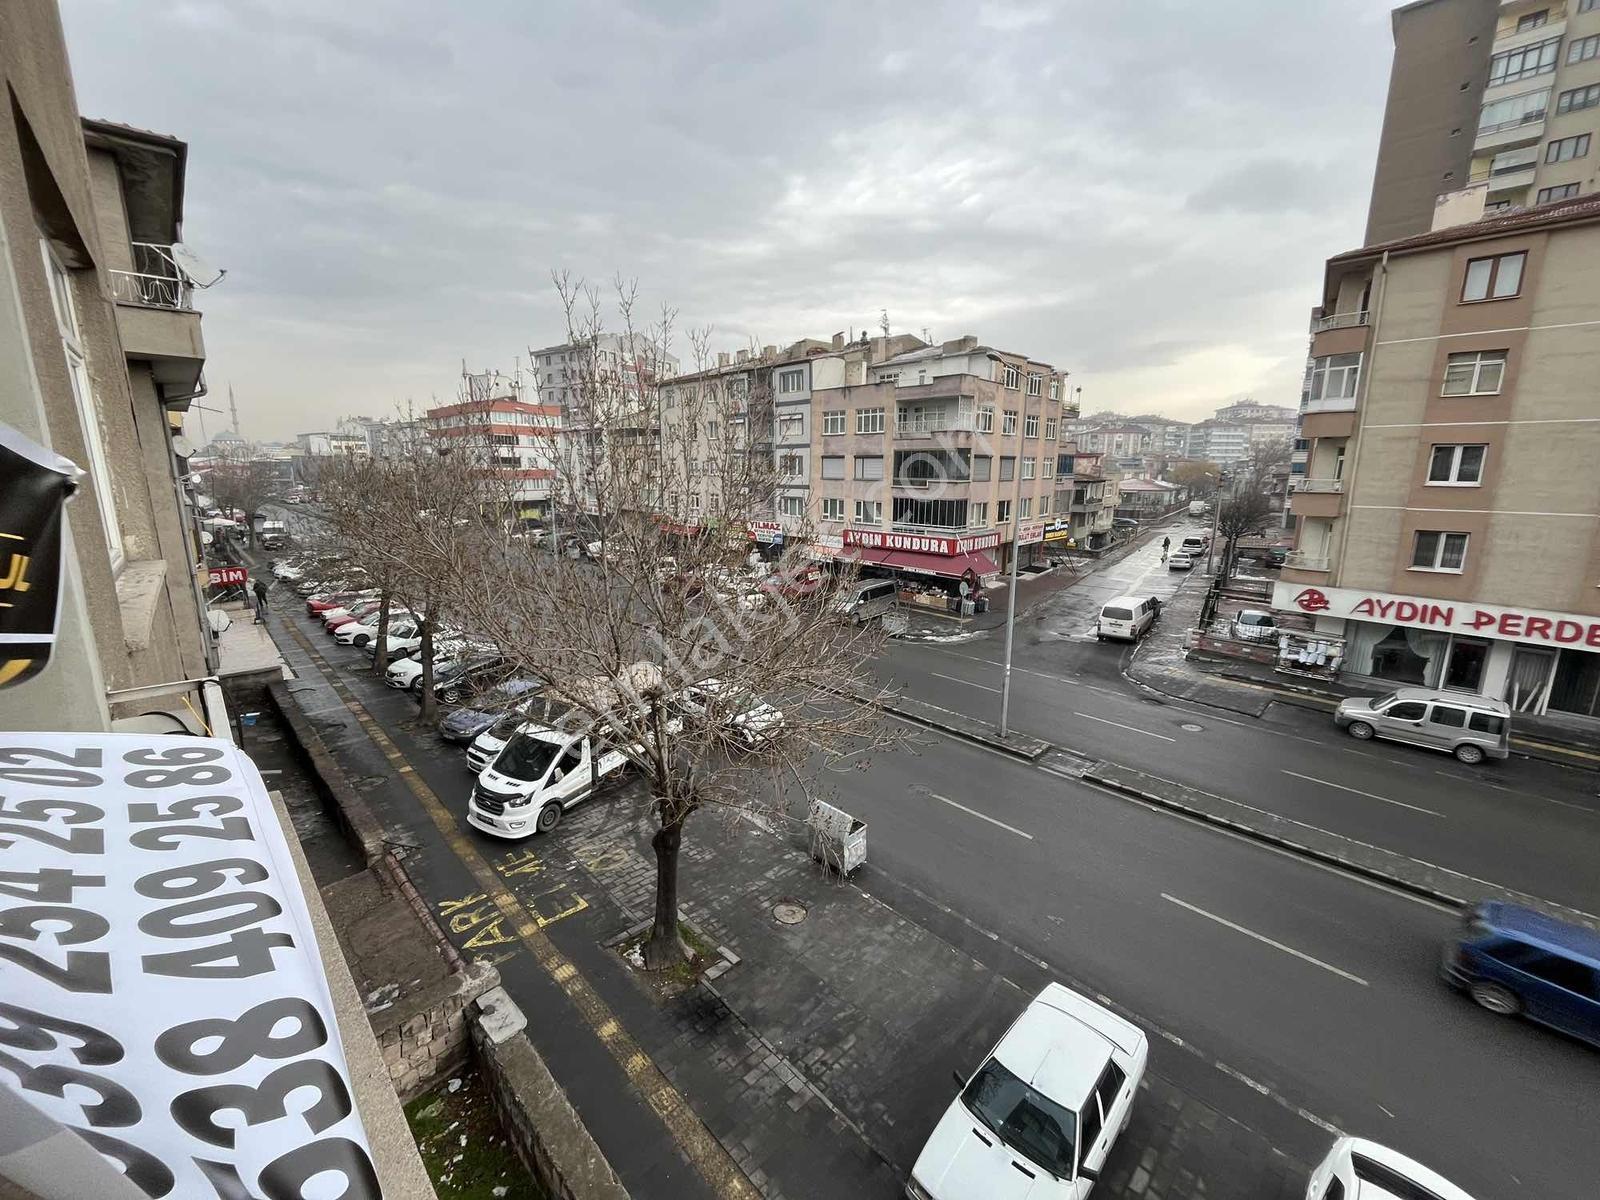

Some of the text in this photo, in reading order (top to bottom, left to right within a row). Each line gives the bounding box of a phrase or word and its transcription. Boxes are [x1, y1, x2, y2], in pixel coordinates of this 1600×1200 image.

[750, 521, 781, 531] YILMAZ
[847, 531, 882, 546] AYDIN
[885, 535, 949, 554] KUNDURA
[974, 534, 999, 550] KUNDURA
[209, 569, 243, 584] BİM
[1350, 597, 1454, 627] AYDIN
[0, 747, 105, 788] 02
[122, 746, 232, 789] 86
[0, 798, 106, 855] 25
[127, 795, 256, 851] 25
[0, 868, 114, 994] 254
[133, 857, 296, 979] 409
